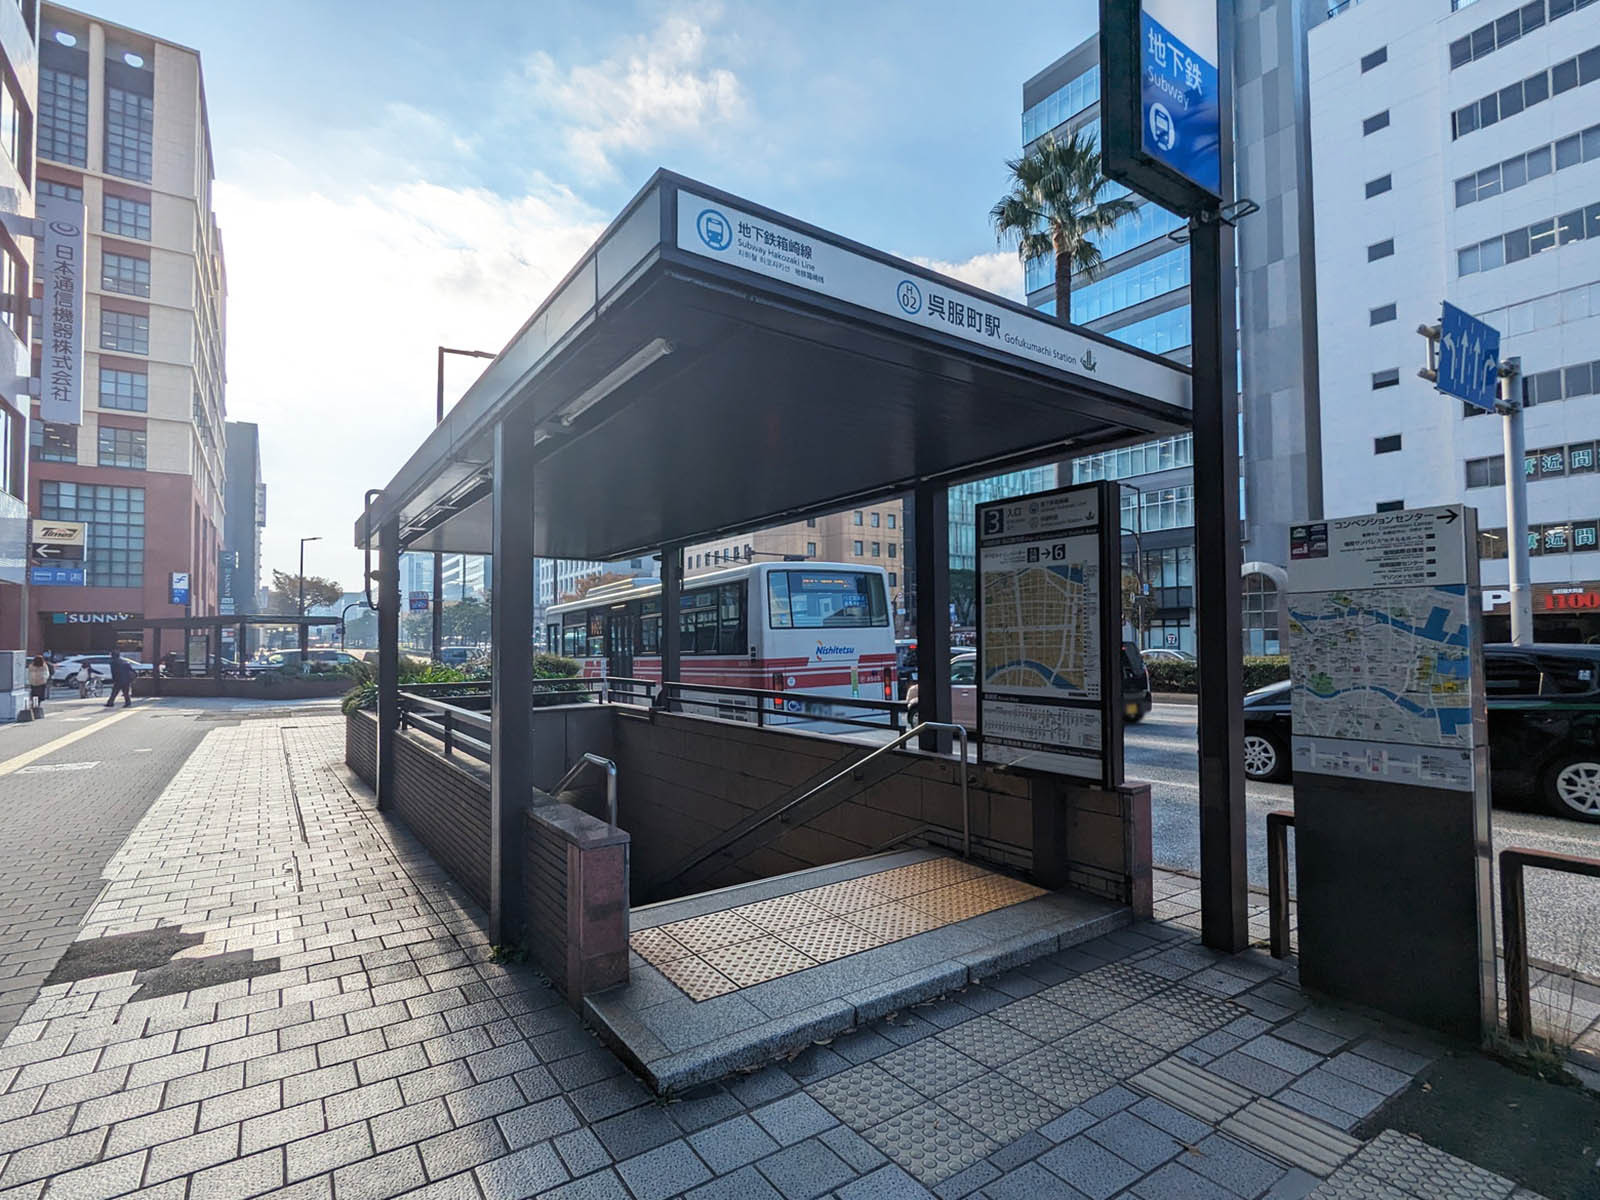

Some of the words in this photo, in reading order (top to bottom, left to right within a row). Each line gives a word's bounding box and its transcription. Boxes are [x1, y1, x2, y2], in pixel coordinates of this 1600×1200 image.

[1147, 26, 1202, 96] 地下鉄
[1147, 65, 1189, 111] Subway
[738, 221, 812, 259] 地下鉄箱崎線
[737, 238, 766, 256] Subway
[767, 249, 800, 265] Hakozaki
[801, 260, 816, 272] Line
[905, 285, 914, 296] H
[902, 294, 917, 310] 02
[51, 243, 74, 403] 日本通信機器株式会社
[927, 293, 1001, 340] 呉服町駅
[1004, 332, 1052, 357] Gofukumachi
[1053, 349, 1077, 365] Station
[988, 511, 1000, 533] 3
[1335, 513, 1434, 528] コンベンションセンター
[41, 527, 78, 538] Times
[1054, 545, 1063, 559] 6
[1482, 590, 1511, 611] P
[815, 645, 855, 655] Nishitetsu
